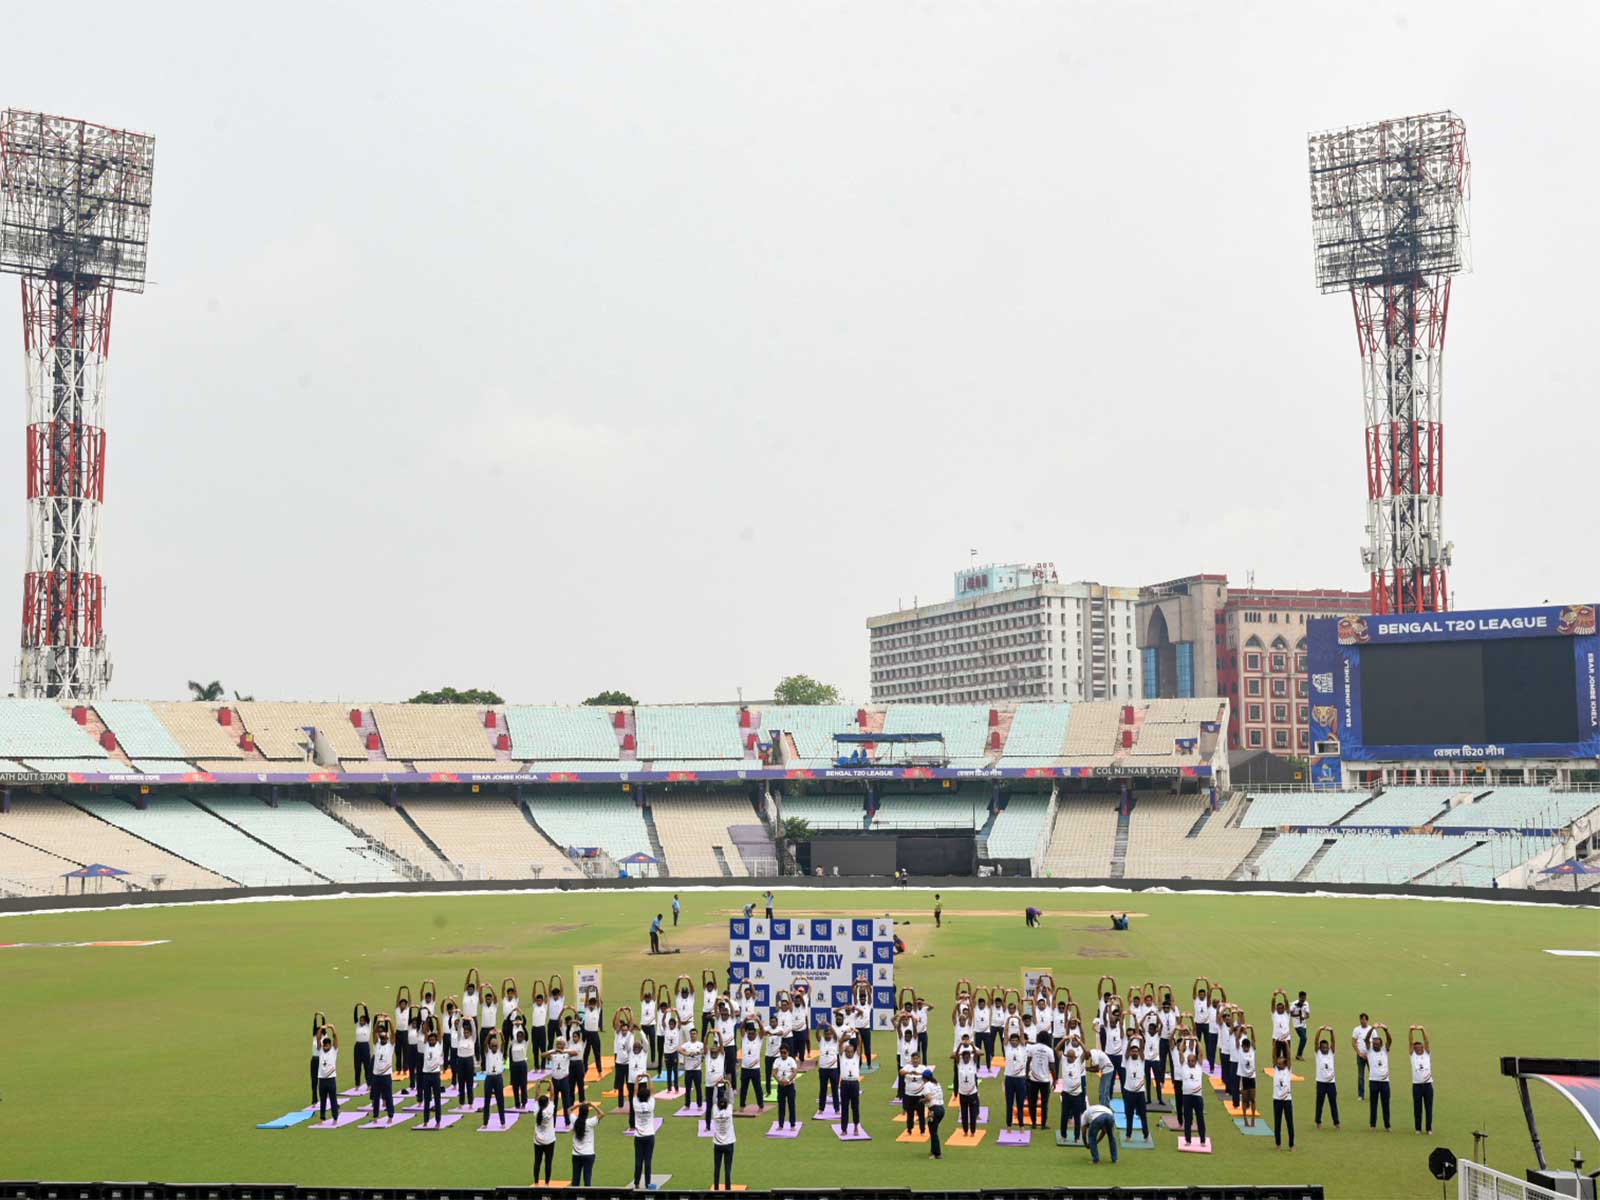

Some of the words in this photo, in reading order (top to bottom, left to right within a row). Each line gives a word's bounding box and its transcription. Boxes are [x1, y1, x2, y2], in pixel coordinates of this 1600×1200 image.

[1378, 621, 1443, 635] BENGAL
[1445, 620, 1475, 632] T20
[1479, 616, 1548, 631] LEAGUE
[1587, 652, 1595, 674] EBAR
[1590, 700, 1598, 727] KHELA
[17, 772, 39, 781] DUTT
[40, 772, 66, 781] STAND
[1096, 767, 1112, 775] COL
[1114, 767, 1125, 775] NJ
[1127, 767, 1148, 775] NAIR
[1150, 767, 1178, 775] STAND
[1306, 827, 1339, 836] BENGAL
[1357, 827, 1392, 836] LEAGUE
[784, 945, 837, 953] INTERNATIONAL
[779, 954, 814, 969] YOGA
[817, 954, 843, 969] DAY
